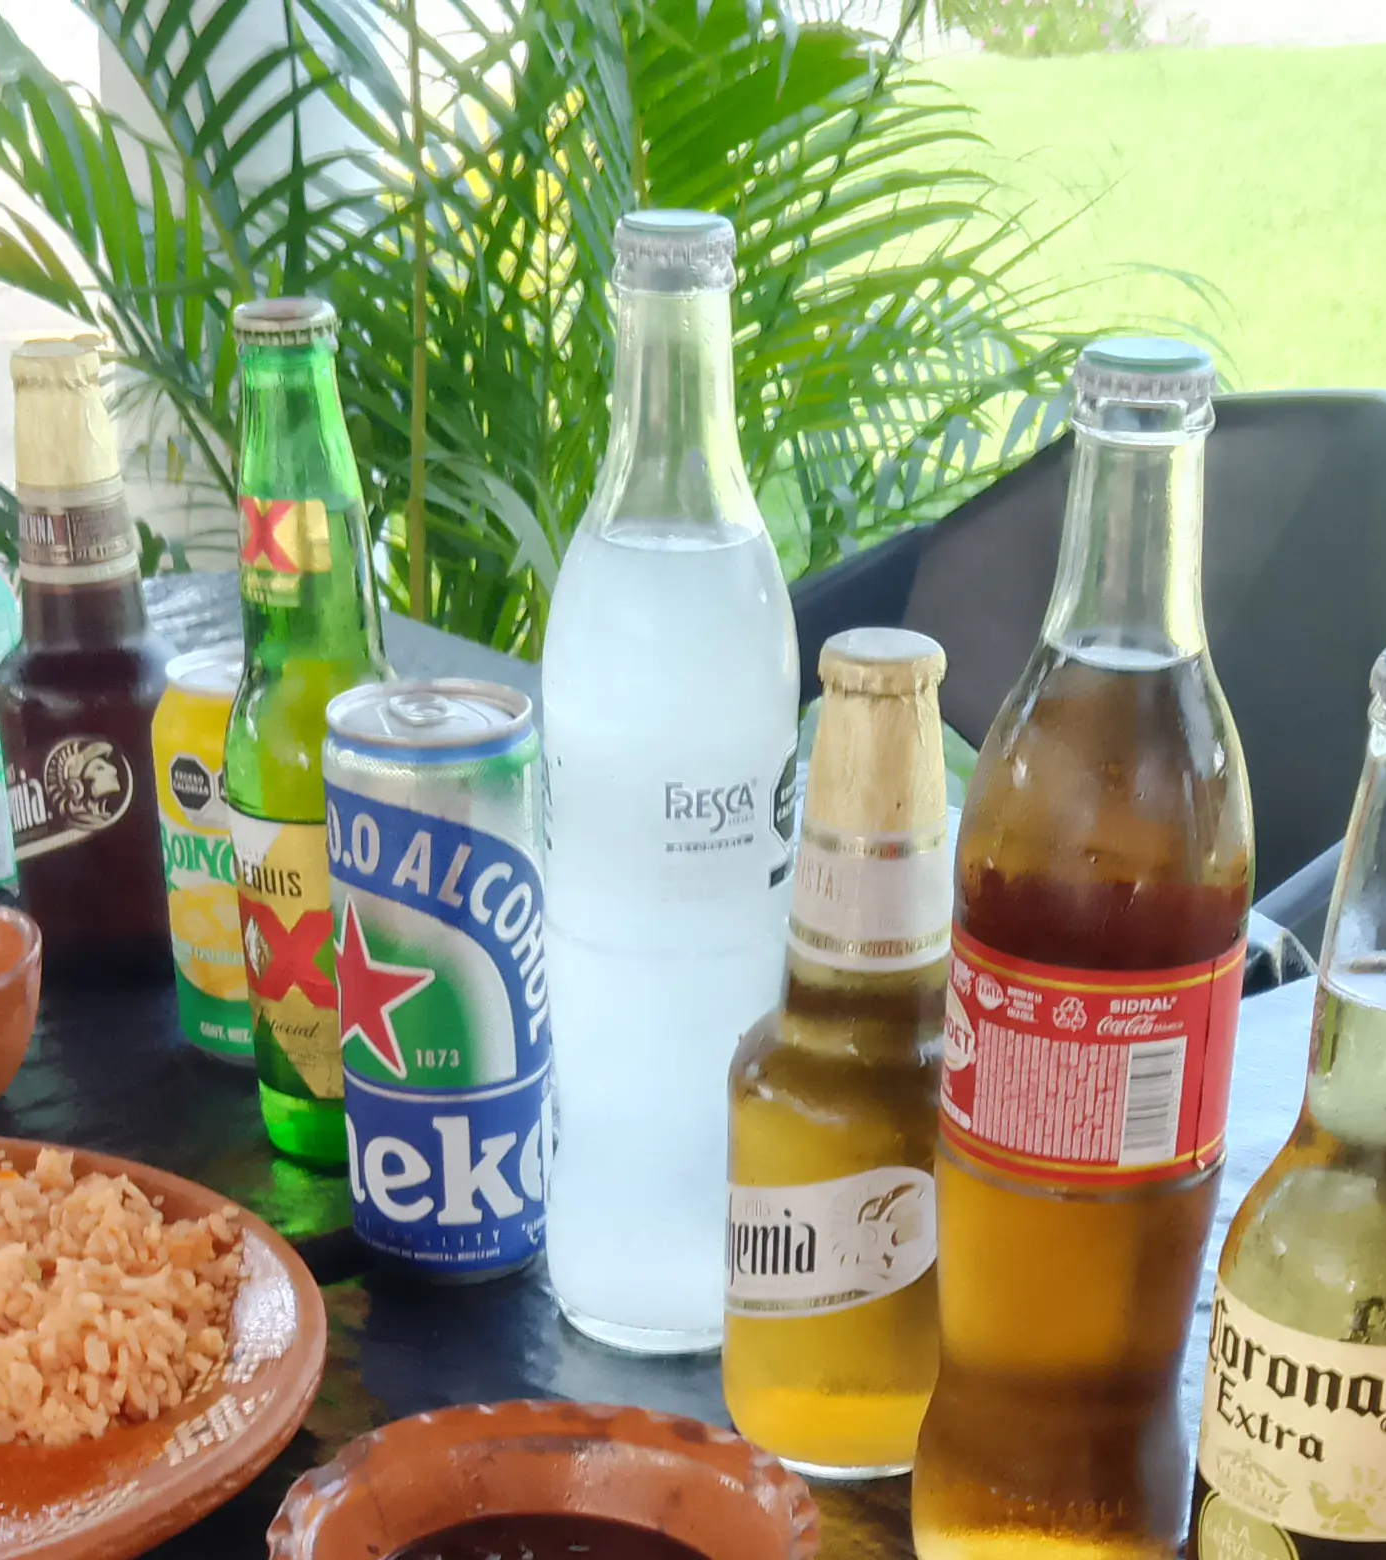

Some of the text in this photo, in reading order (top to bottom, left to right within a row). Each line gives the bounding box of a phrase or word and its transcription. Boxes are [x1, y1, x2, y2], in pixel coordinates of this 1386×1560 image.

[665, 781, 755, 834] FRESCA
[391, 829, 550, 1046] ALCOHOL
[415, 1048, 461, 1069] 1873
[1217, 1371, 1326, 1463] Extra
